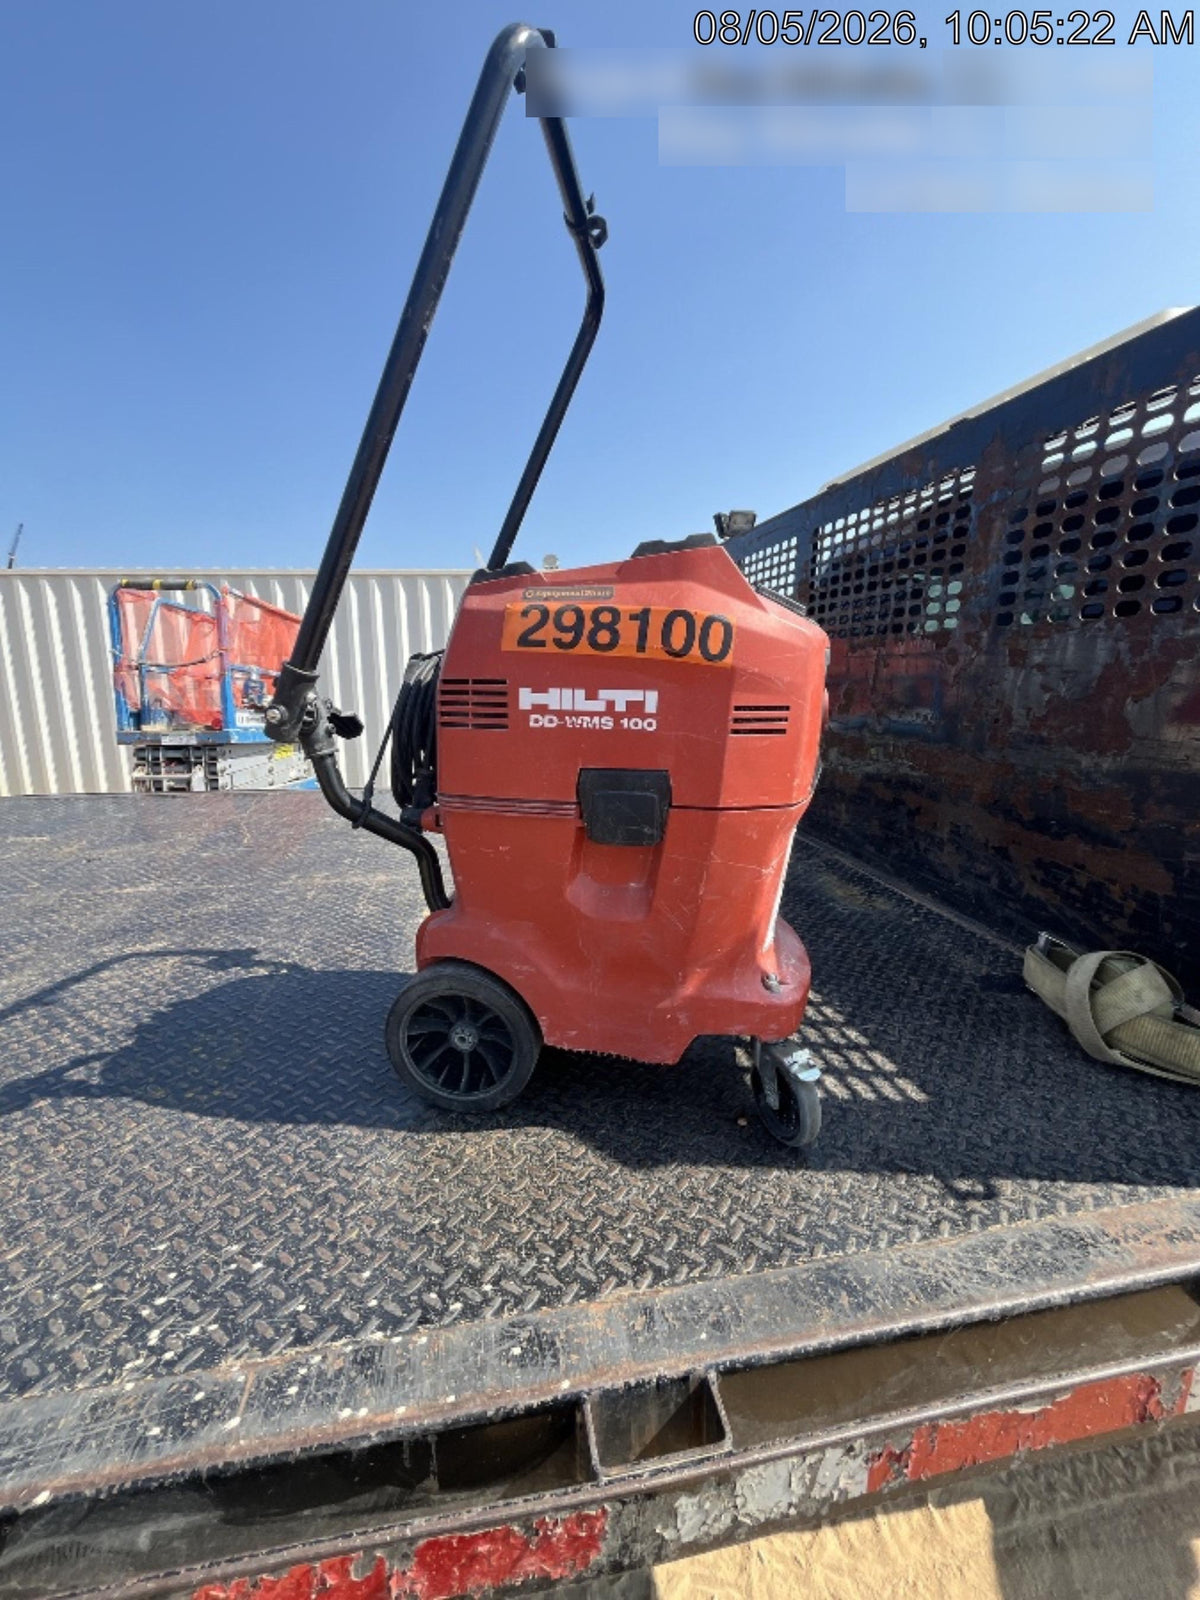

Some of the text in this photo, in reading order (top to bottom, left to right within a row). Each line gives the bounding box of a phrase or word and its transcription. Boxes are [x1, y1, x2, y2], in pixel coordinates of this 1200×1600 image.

[517, 604, 733, 663] 298100
[519, 687, 658, 713] HILTI
[529, 714, 657, 732] DD-WMS 100
